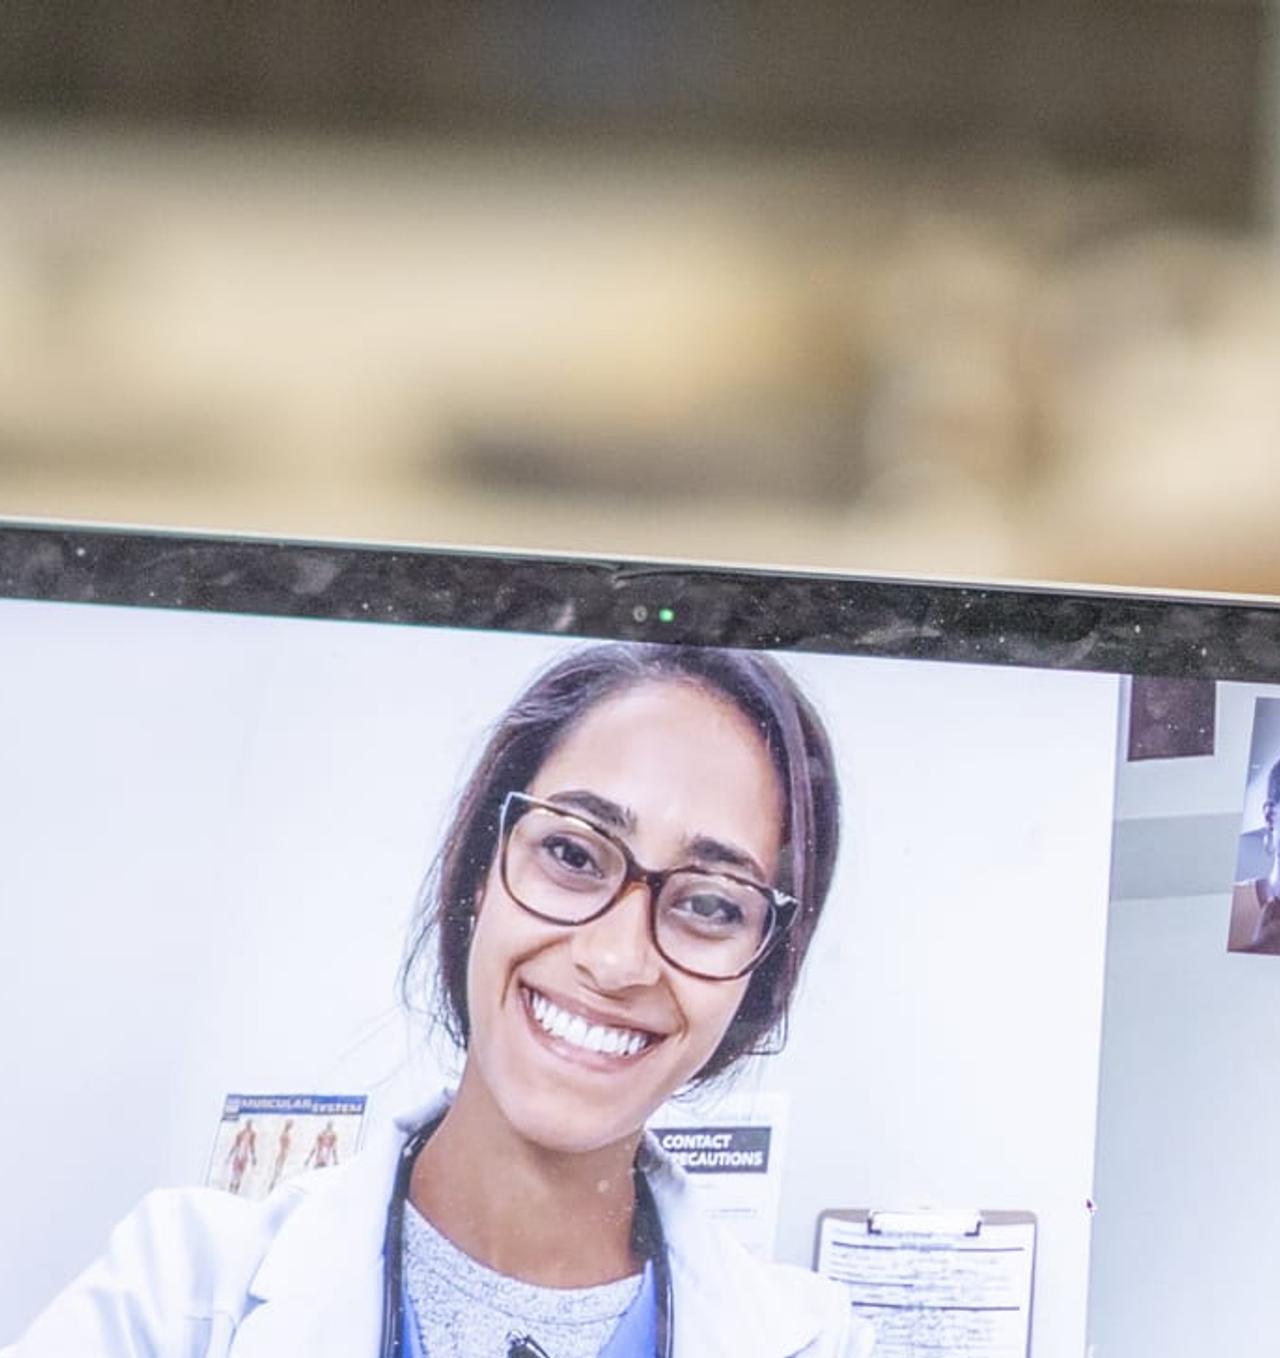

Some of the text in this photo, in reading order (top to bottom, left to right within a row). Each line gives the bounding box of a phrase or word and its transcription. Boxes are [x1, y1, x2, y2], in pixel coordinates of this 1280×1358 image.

[312, 1101, 365, 1113] SYSTEM
[662, 1133, 733, 1149] CONTACT
[669, 1151, 764, 1167] RECAUTIONS
